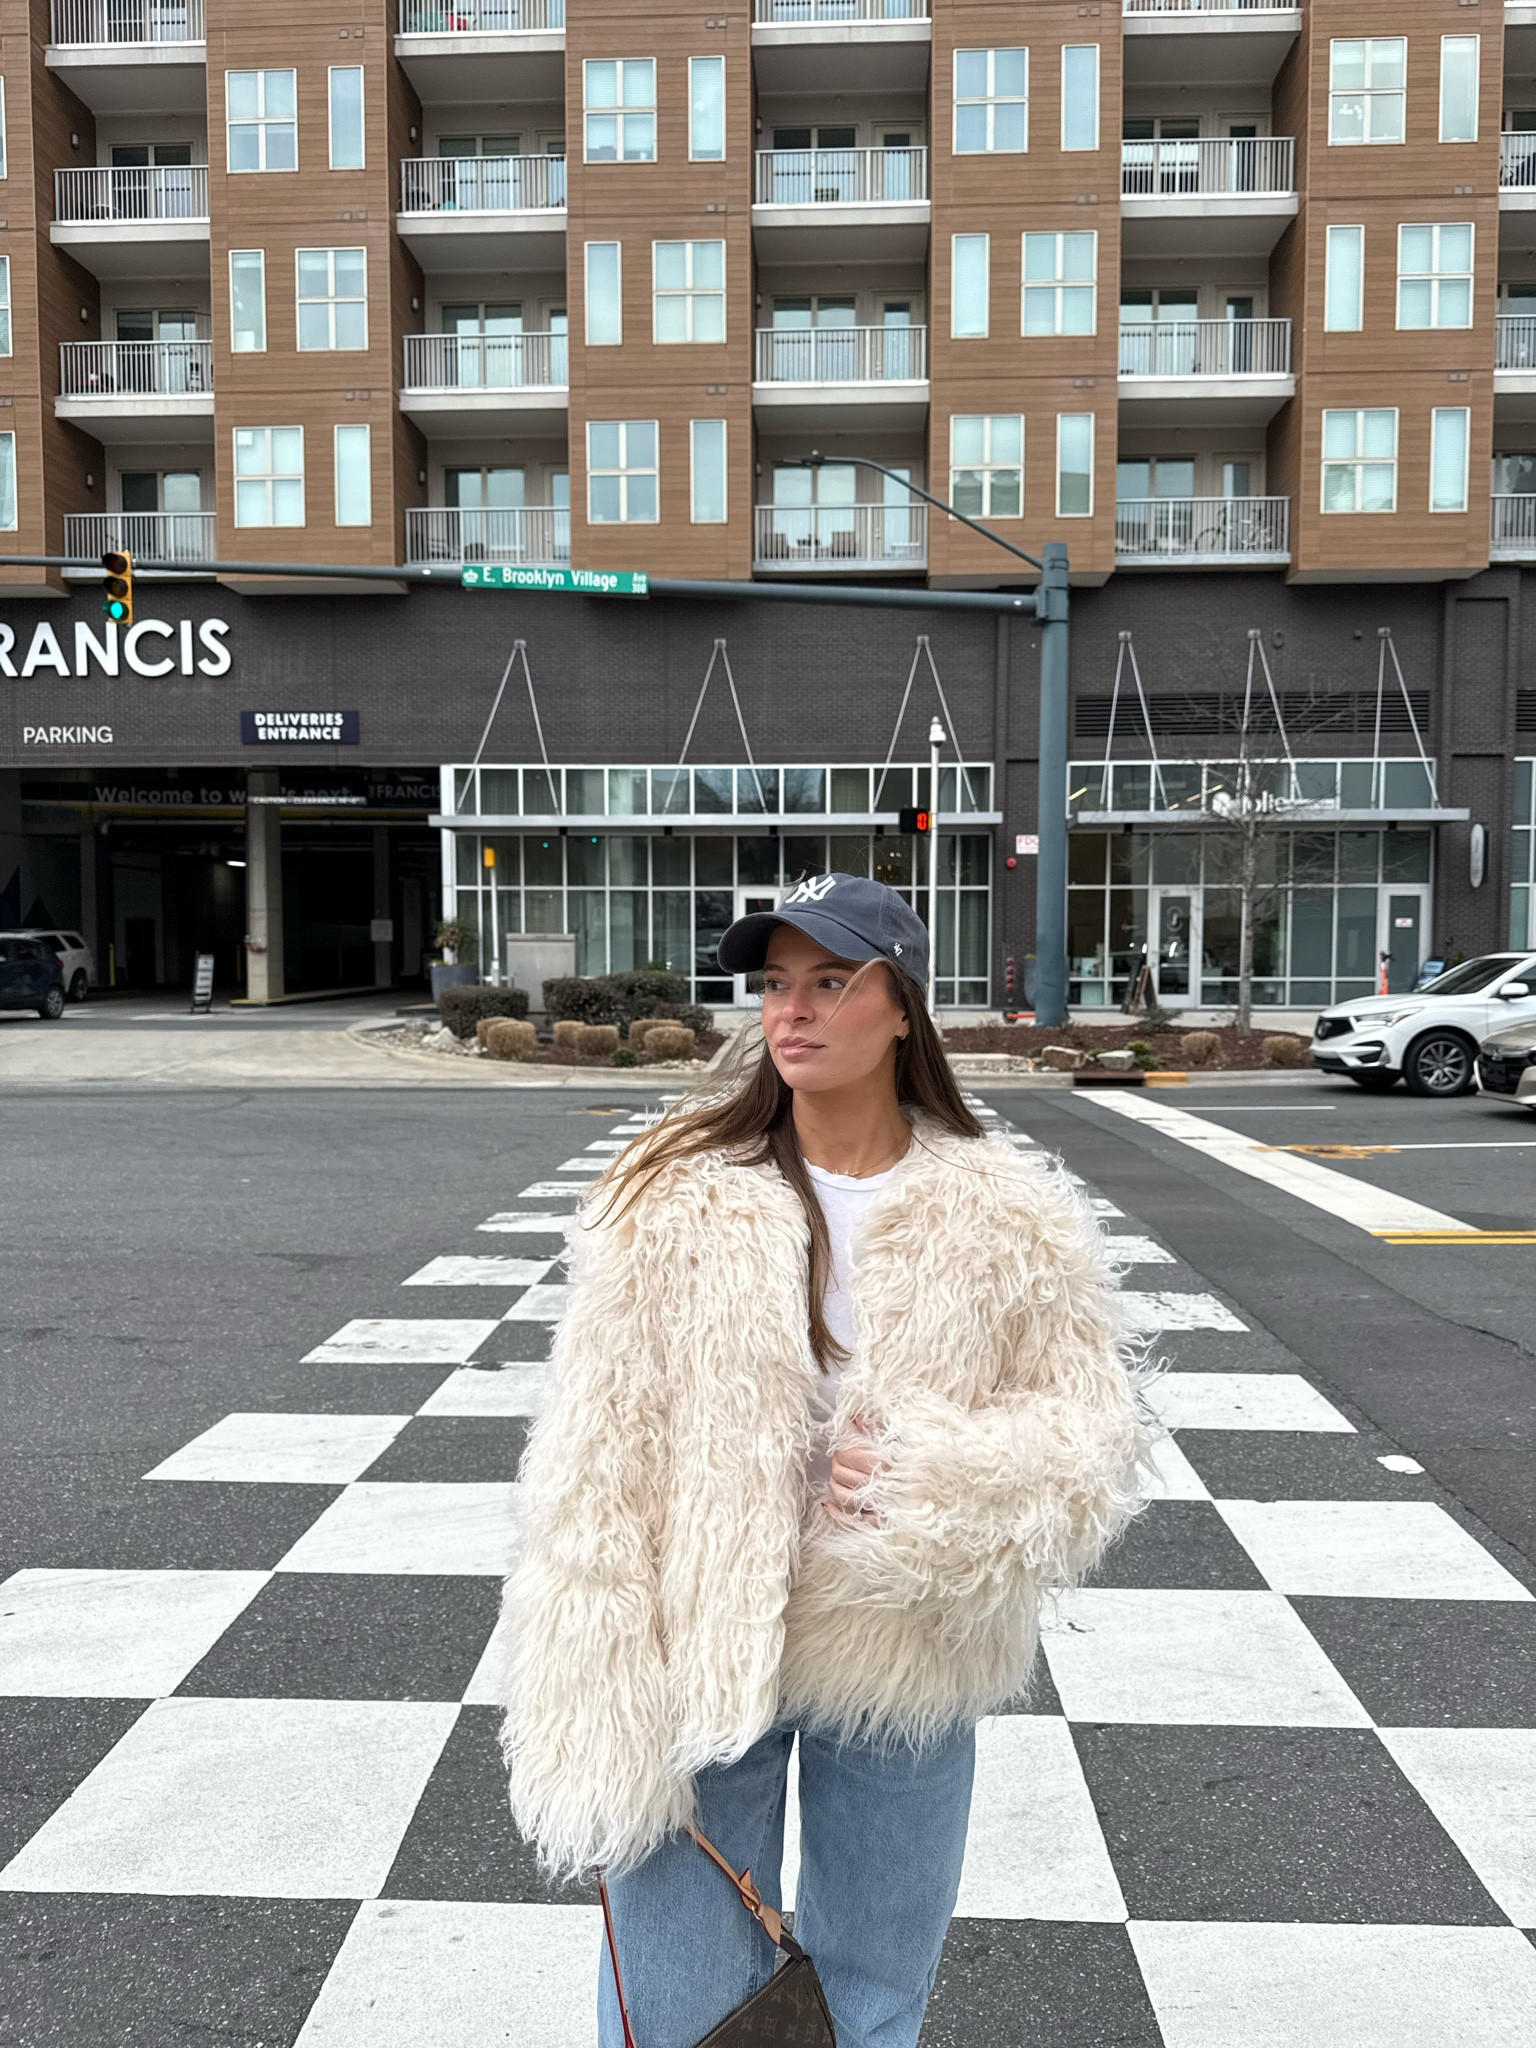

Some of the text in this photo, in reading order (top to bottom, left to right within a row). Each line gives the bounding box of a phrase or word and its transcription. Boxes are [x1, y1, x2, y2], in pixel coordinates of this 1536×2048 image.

[482, 566, 618, 591] E. Brooklyn Village
[254, 712, 344, 726] DELIVERIES
[23, 726, 113, 744] PARKING
[257, 727, 341, 740] ENTRANCE
[95, 786, 194, 804] Welcome
[200, 788, 223, 804] to
[785, 876, 836, 903] NY
